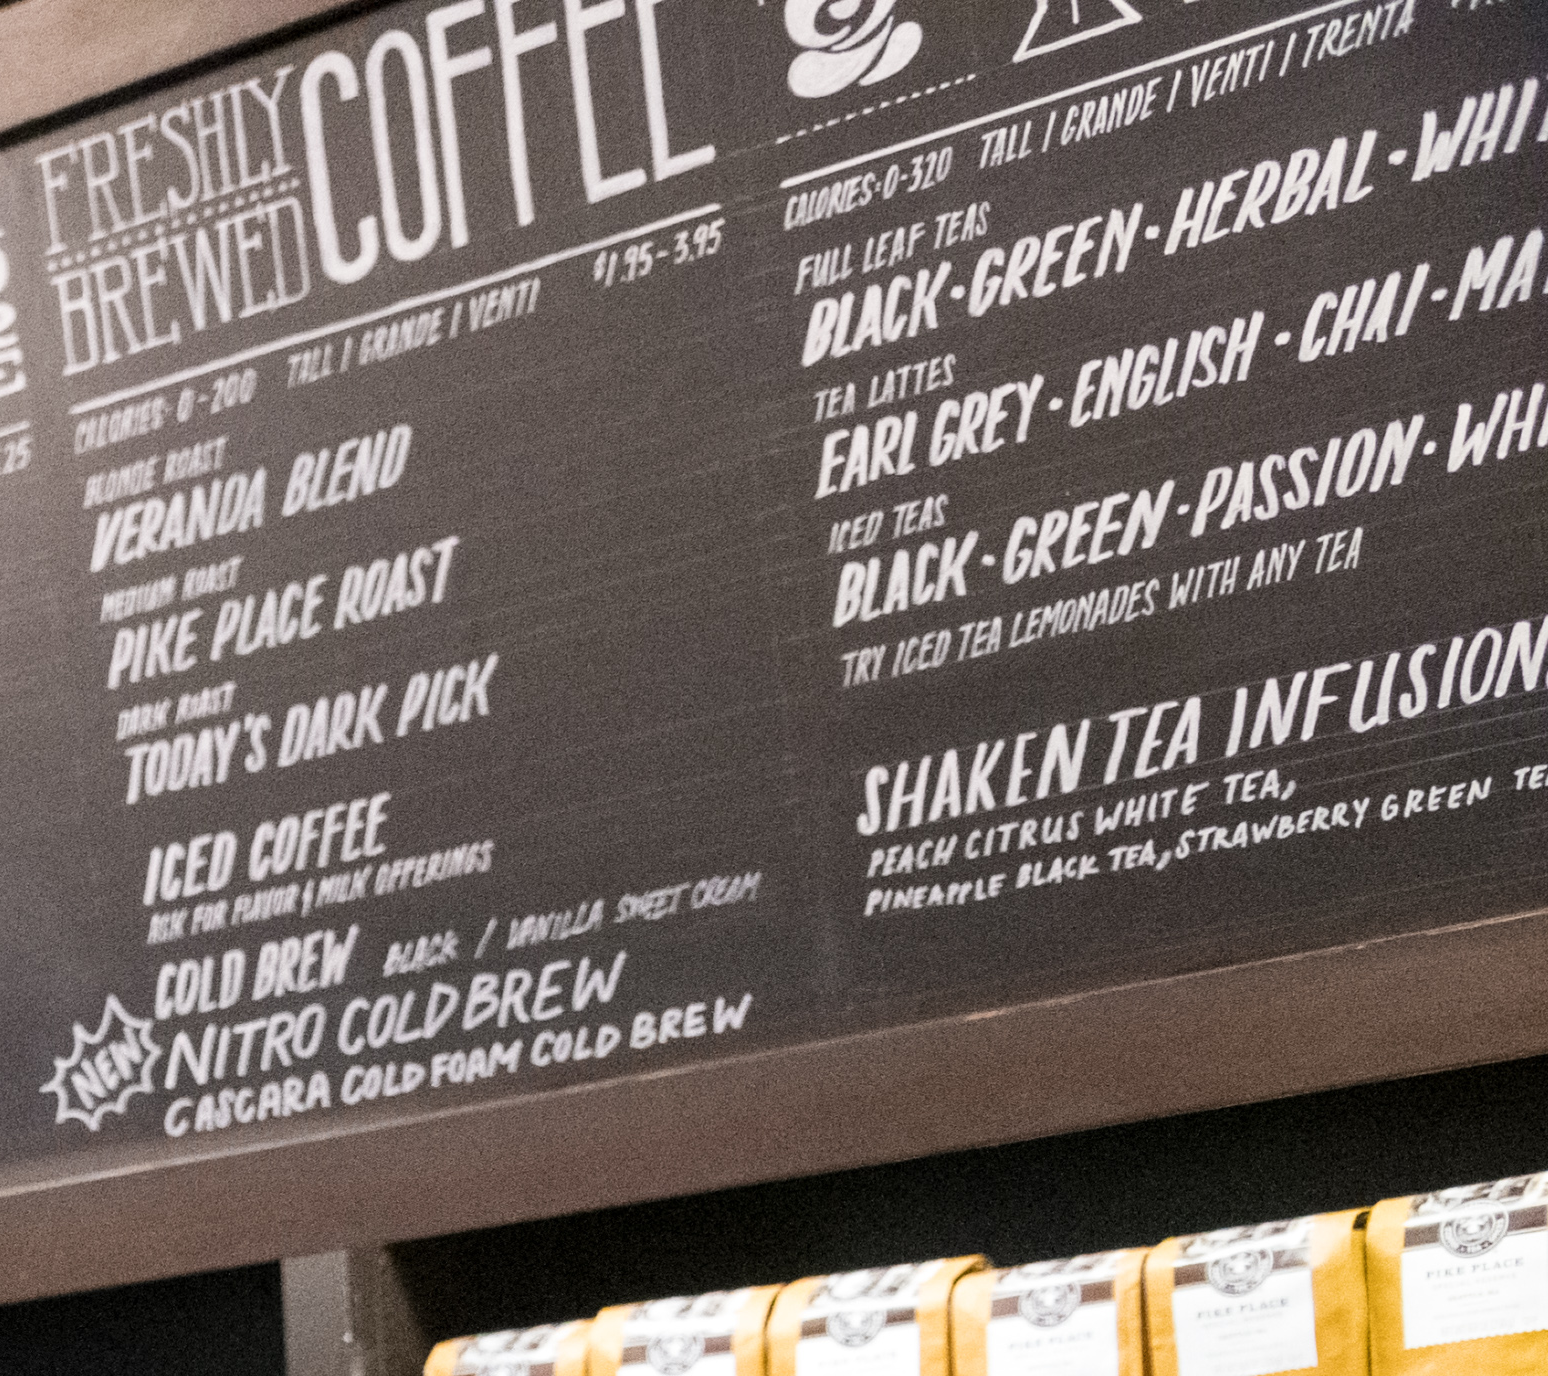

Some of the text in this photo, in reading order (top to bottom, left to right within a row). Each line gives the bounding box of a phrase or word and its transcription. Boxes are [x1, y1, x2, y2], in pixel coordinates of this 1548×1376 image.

[979, 0, 1414, 169] TALL GRANDE VENTI TRENTA
[36, 62, 297, 256] FRESHLY
[51, 195, 312, 376] BREWED
[794, 201, 991, 295] FULL LEAF TEAS
[802, 129, 1377, 368] BLACK GREEN HERBAL
[286, 278, 540, 389] TALL GRANDE VENTI
[815, 262, 1430, 500] EARL GREY ENGLISH CHAI
[815, 354, 957, 423] TEA LATTES
[84, 435, 229, 509] BLONDE ROAST
[90, 423, 412, 573] VERANDA BLEND
[828, 494, 949, 554] ICED TEAS
[833, 412, 1426, 628] BLACK GREEN PASSION
[100, 556, 245, 623] MEDIUM ROAST
[107, 536, 461, 690] PIKE PLACE ROAST
[841, 527, 1364, 688] TRY ICED TEA LEMONADES WITH ANY TEA
[116, 681, 237, 741] DARK ROAST
[125, 653, 499, 805] TODAY'S DARK PICK
[857, 614, 1548, 836] SHAKEN TEA INFUSION
[143, 792, 392, 906] ICED COFFEE
[147, 839, 495, 946] ASK FOR FLAVOR MILK OFFERINGS
[864, 776, 1493, 917] PINEAPPLE BLACK TEA, STRAWBERRY GREEN
[866, 769, 1297, 878] PEACH CITRUS WHITE TEA,
[156, 871, 762, 1021] COLD BREW BLACK VANILLA CREAM
[71, 1025, 145, 1110] NEW
[165, 950, 628, 1091] NITRO COLD BREW
[165, 993, 753, 1137] CASCARA COLD FOAM COLD BREW
[1425, 1256, 1525, 1280] PIKE PLACE
